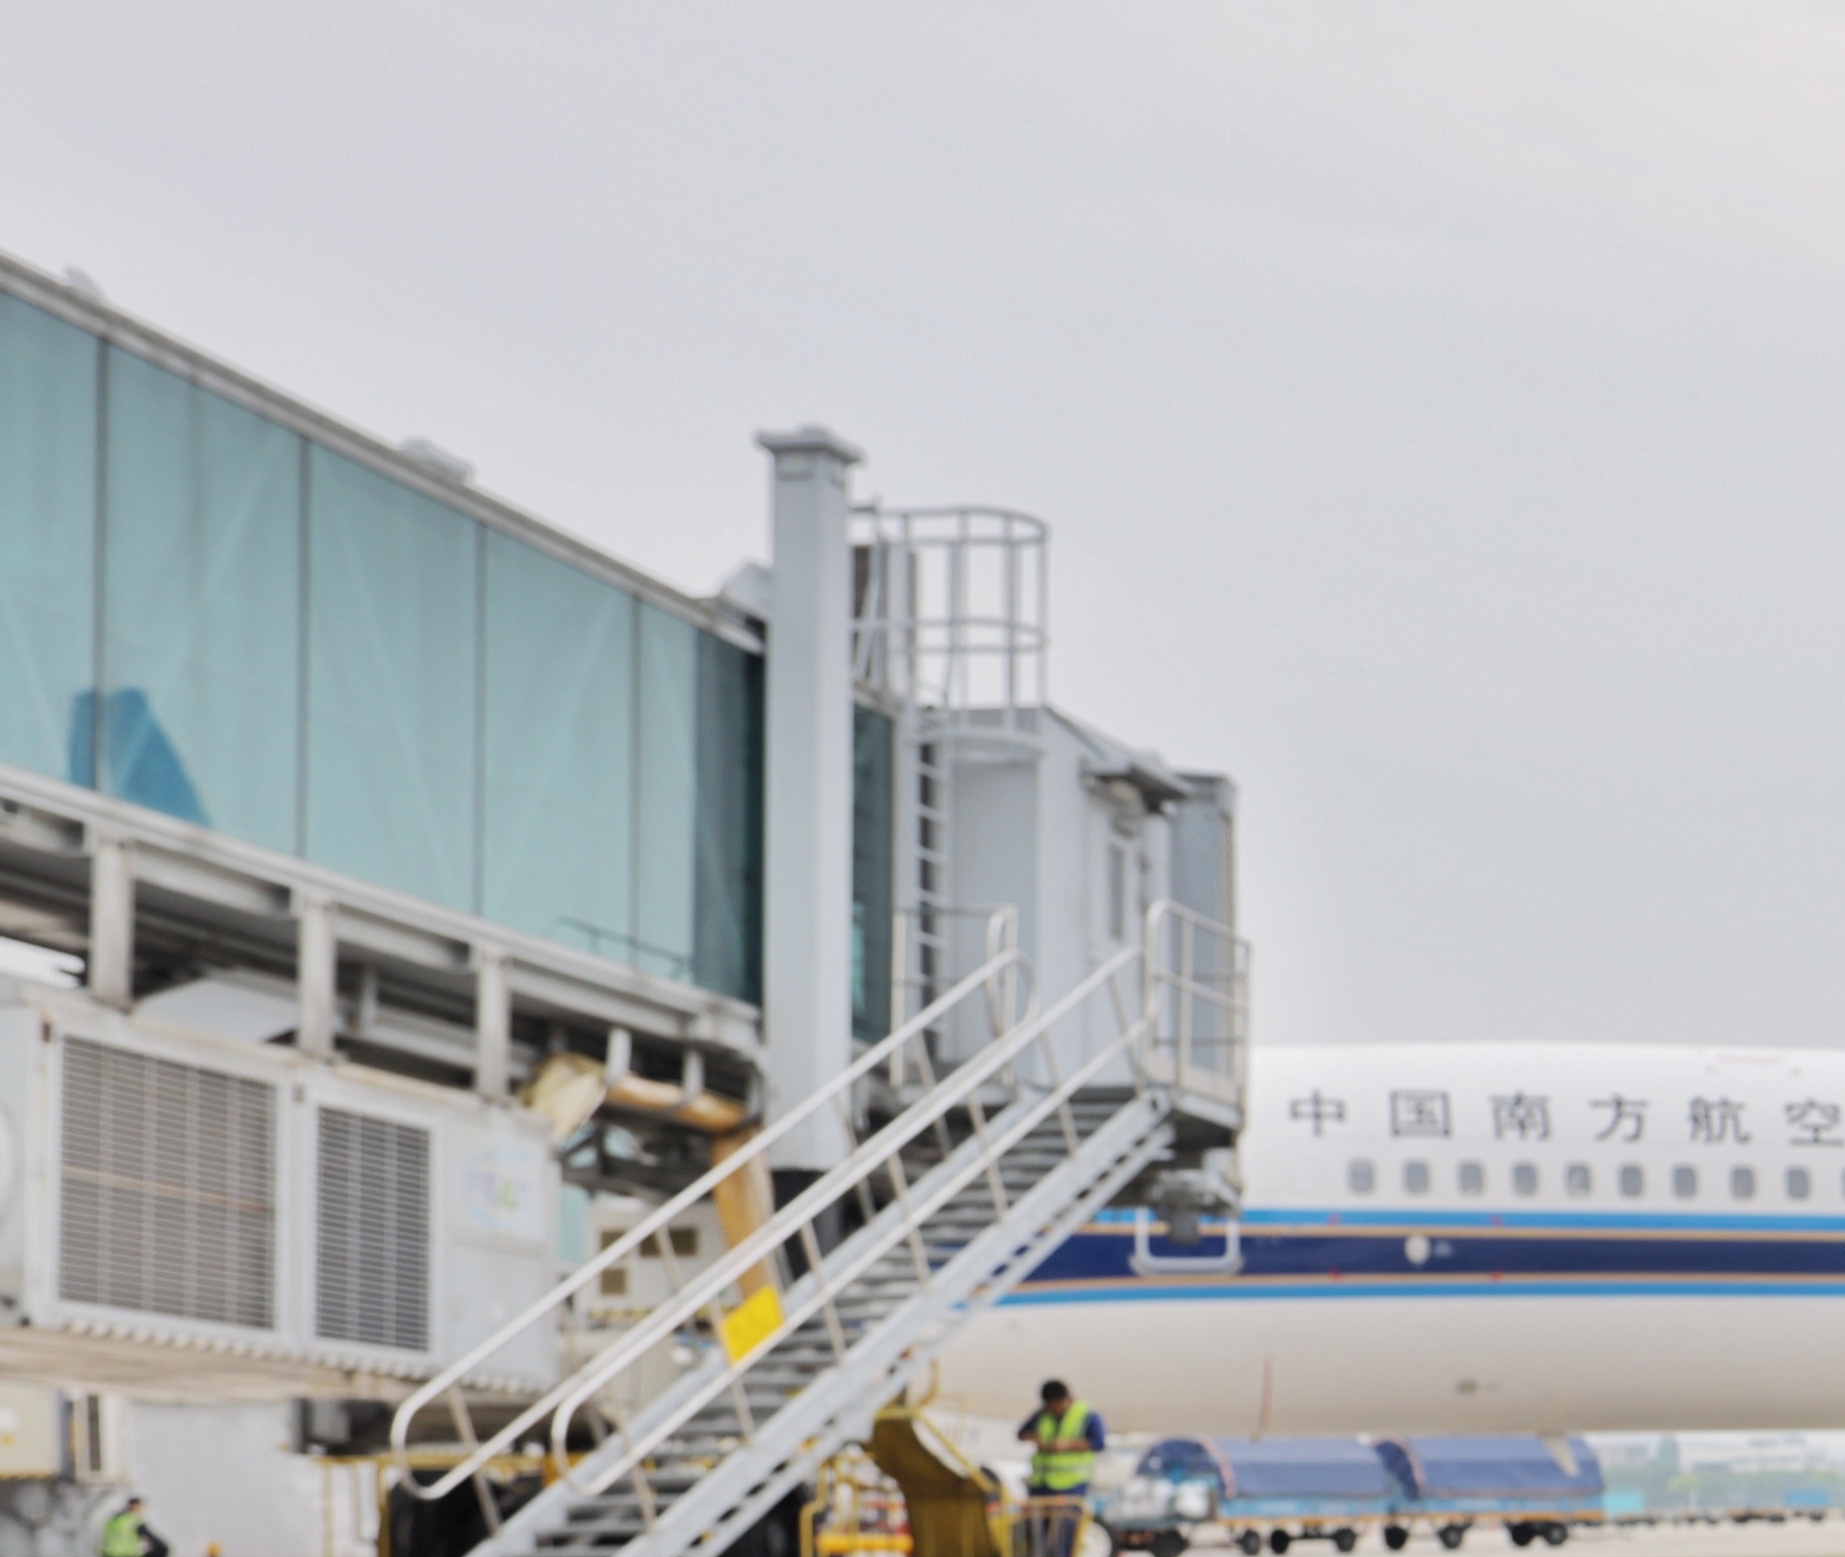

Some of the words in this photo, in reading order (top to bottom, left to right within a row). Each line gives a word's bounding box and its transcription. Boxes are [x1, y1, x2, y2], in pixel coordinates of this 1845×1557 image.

[1290, 1088, 1845, 1148] 中国南方航空
